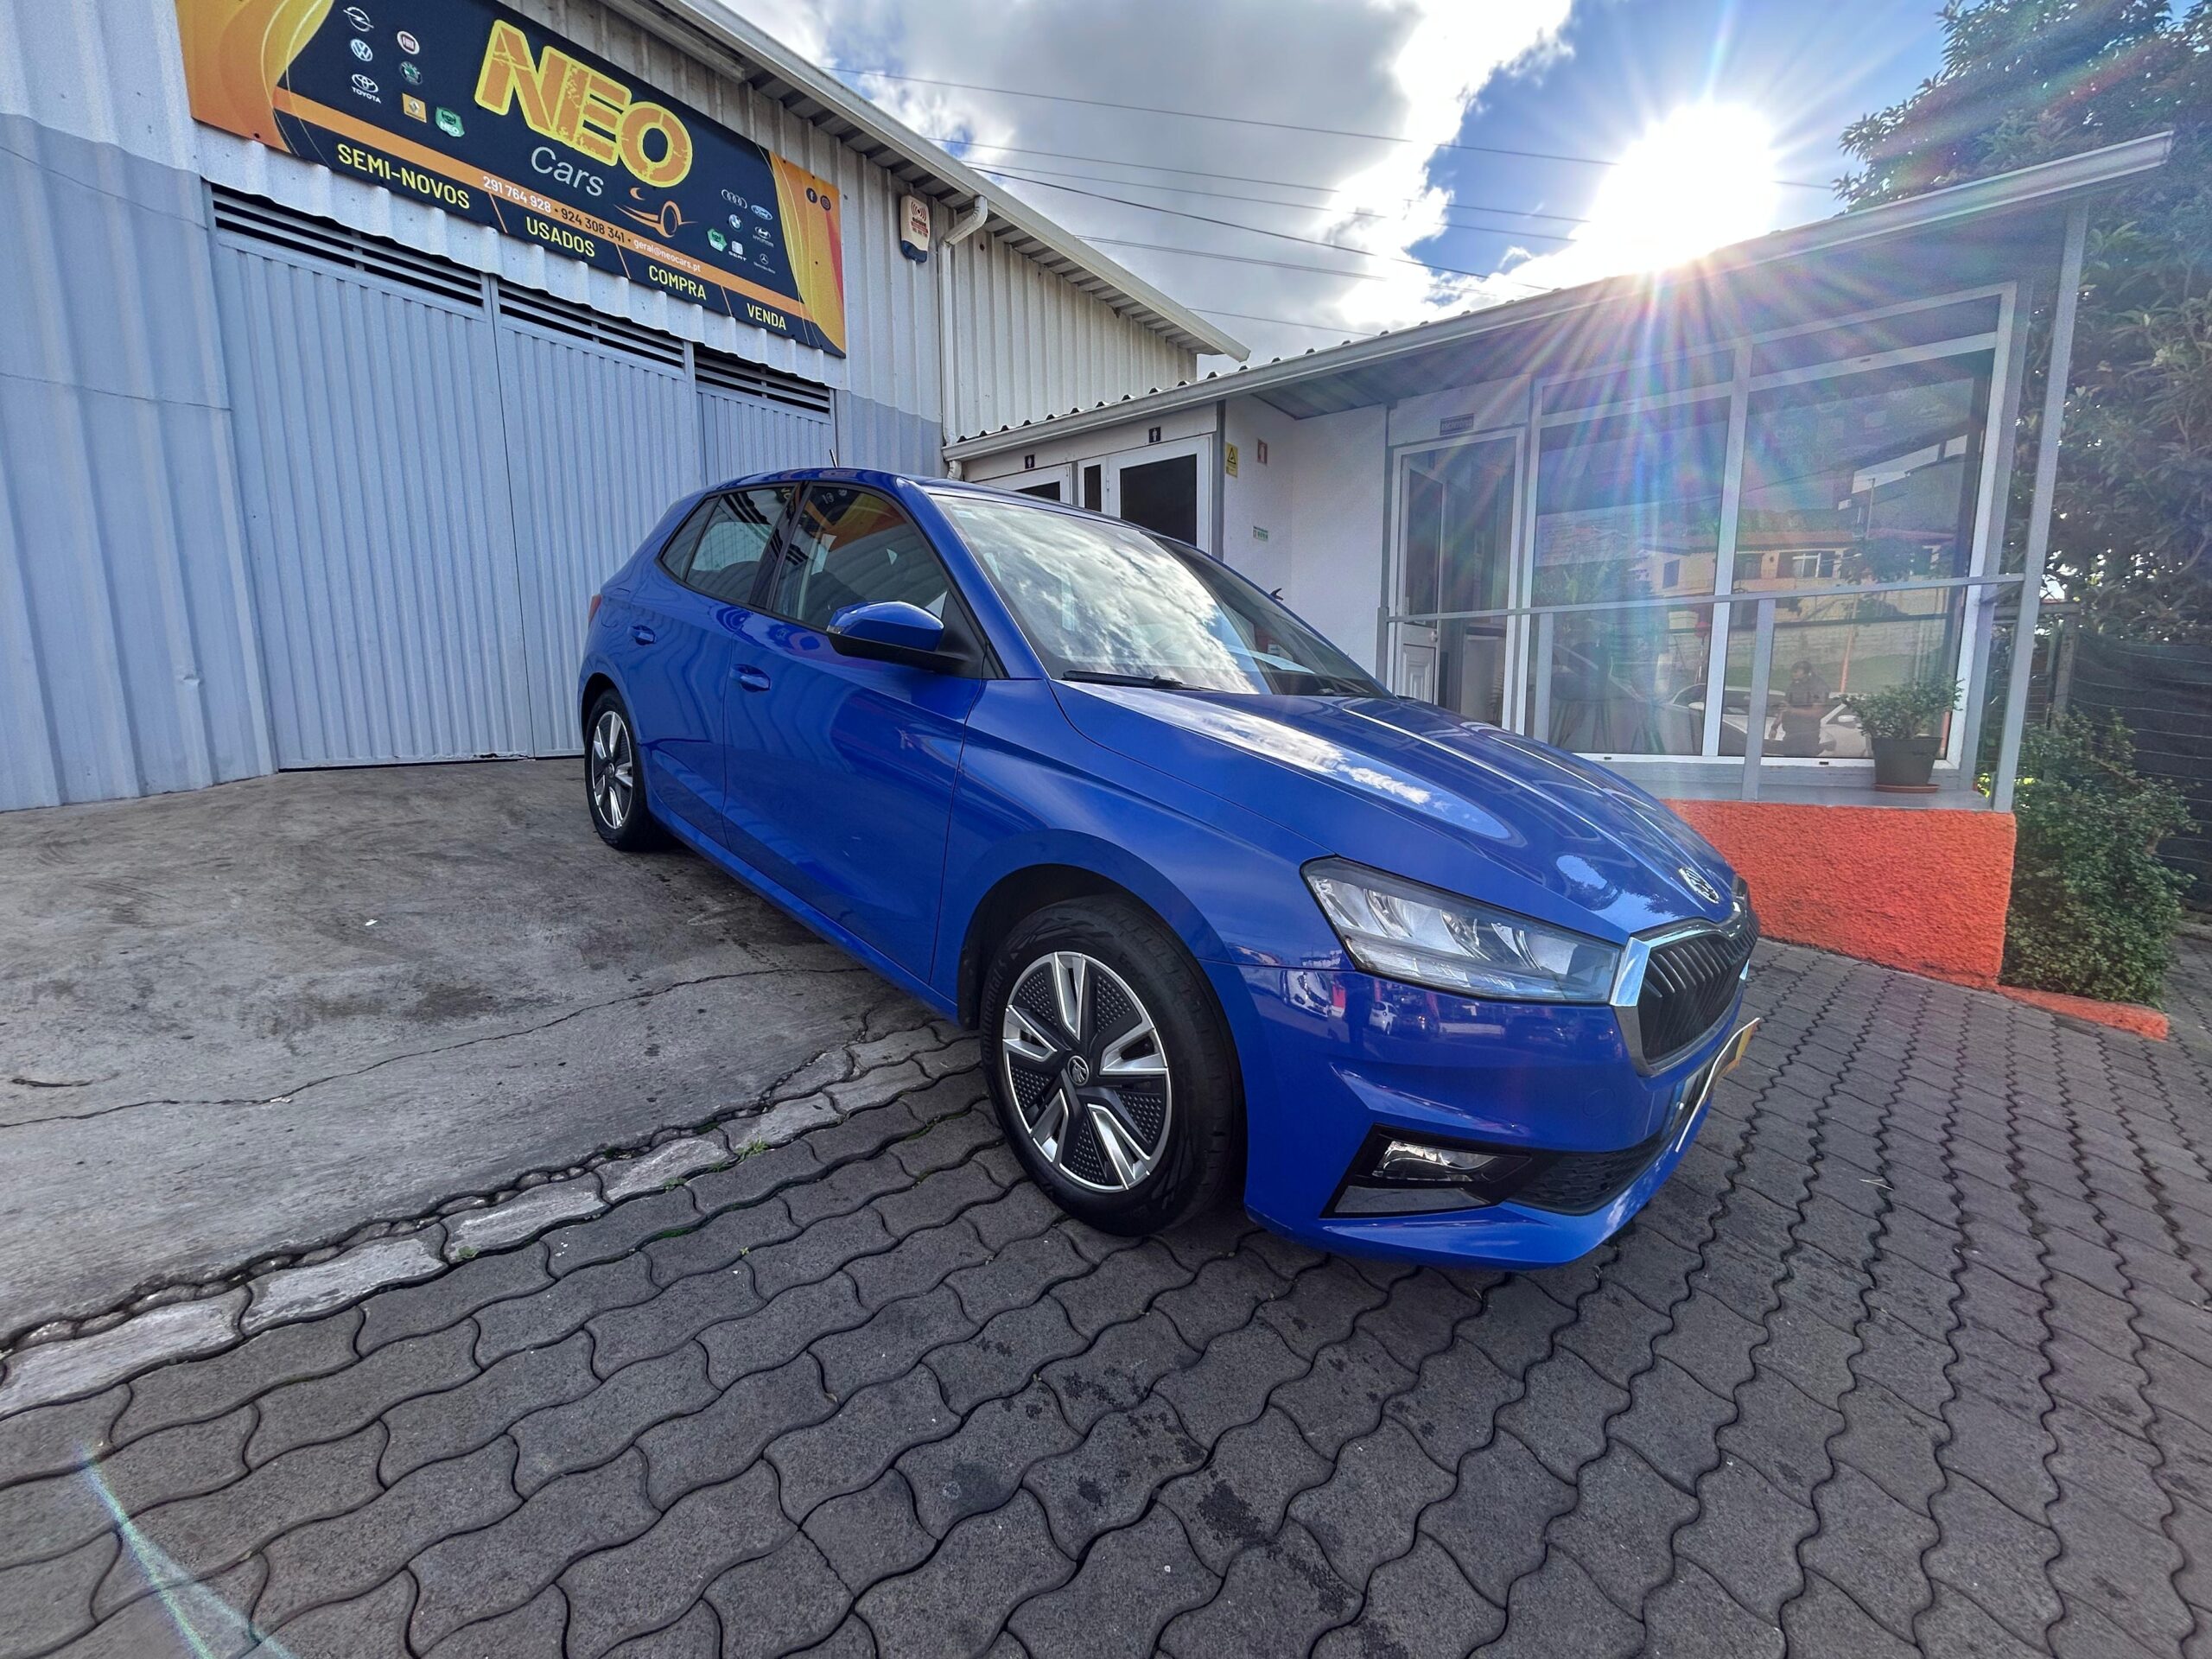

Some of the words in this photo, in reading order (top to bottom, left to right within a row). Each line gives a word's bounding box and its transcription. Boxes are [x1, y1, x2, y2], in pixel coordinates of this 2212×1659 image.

[351, 86, 382, 104] TOYOTA
[474, 19, 693, 188] NEO
[337, 143, 470, 209] SEMI-NOVOS
[531, 146, 604, 196] Cars
[482, 175, 503, 194] 291
[506, 185, 528, 204] 764
[530, 195, 551, 213] 928
[561, 207, 582, 226] 924
[585, 217, 606, 235] 308
[607, 226, 625, 243] 341
[633, 238, 702, 272] geral@neocars.pt
[525, 217, 595, 257] USADOS
[649, 264, 707, 301] COMPRA
[747, 302, 787, 331] VENDA
